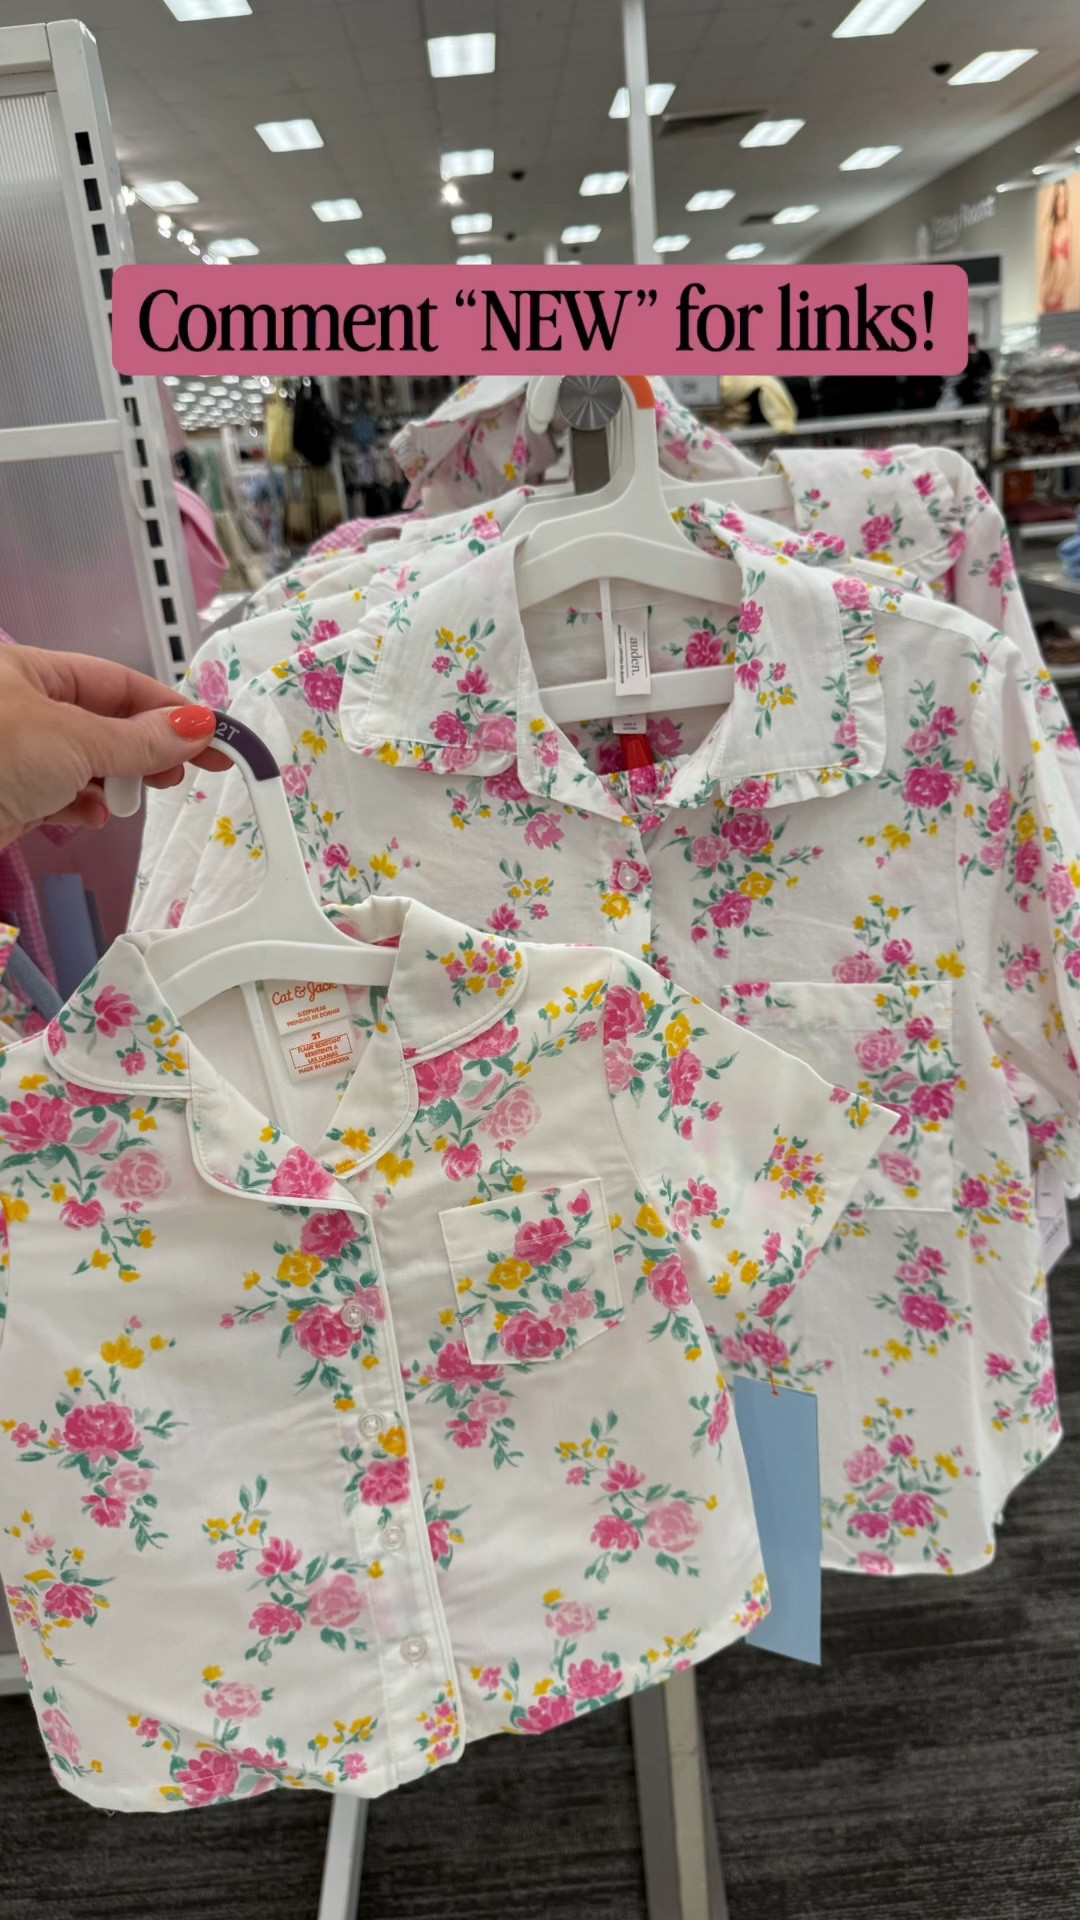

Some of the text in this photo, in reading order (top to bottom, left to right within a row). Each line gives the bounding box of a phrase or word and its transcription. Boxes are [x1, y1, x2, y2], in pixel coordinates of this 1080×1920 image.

[215, 721, 240, 741] 2T
[271, 989, 293, 1006] Cat
[294, 985, 307, 999] &
[311, 1032, 321, 1041] 2T
[298, 1066, 314, 1074] MADE
[321, 1056, 350, 1068] CAMBODIA
